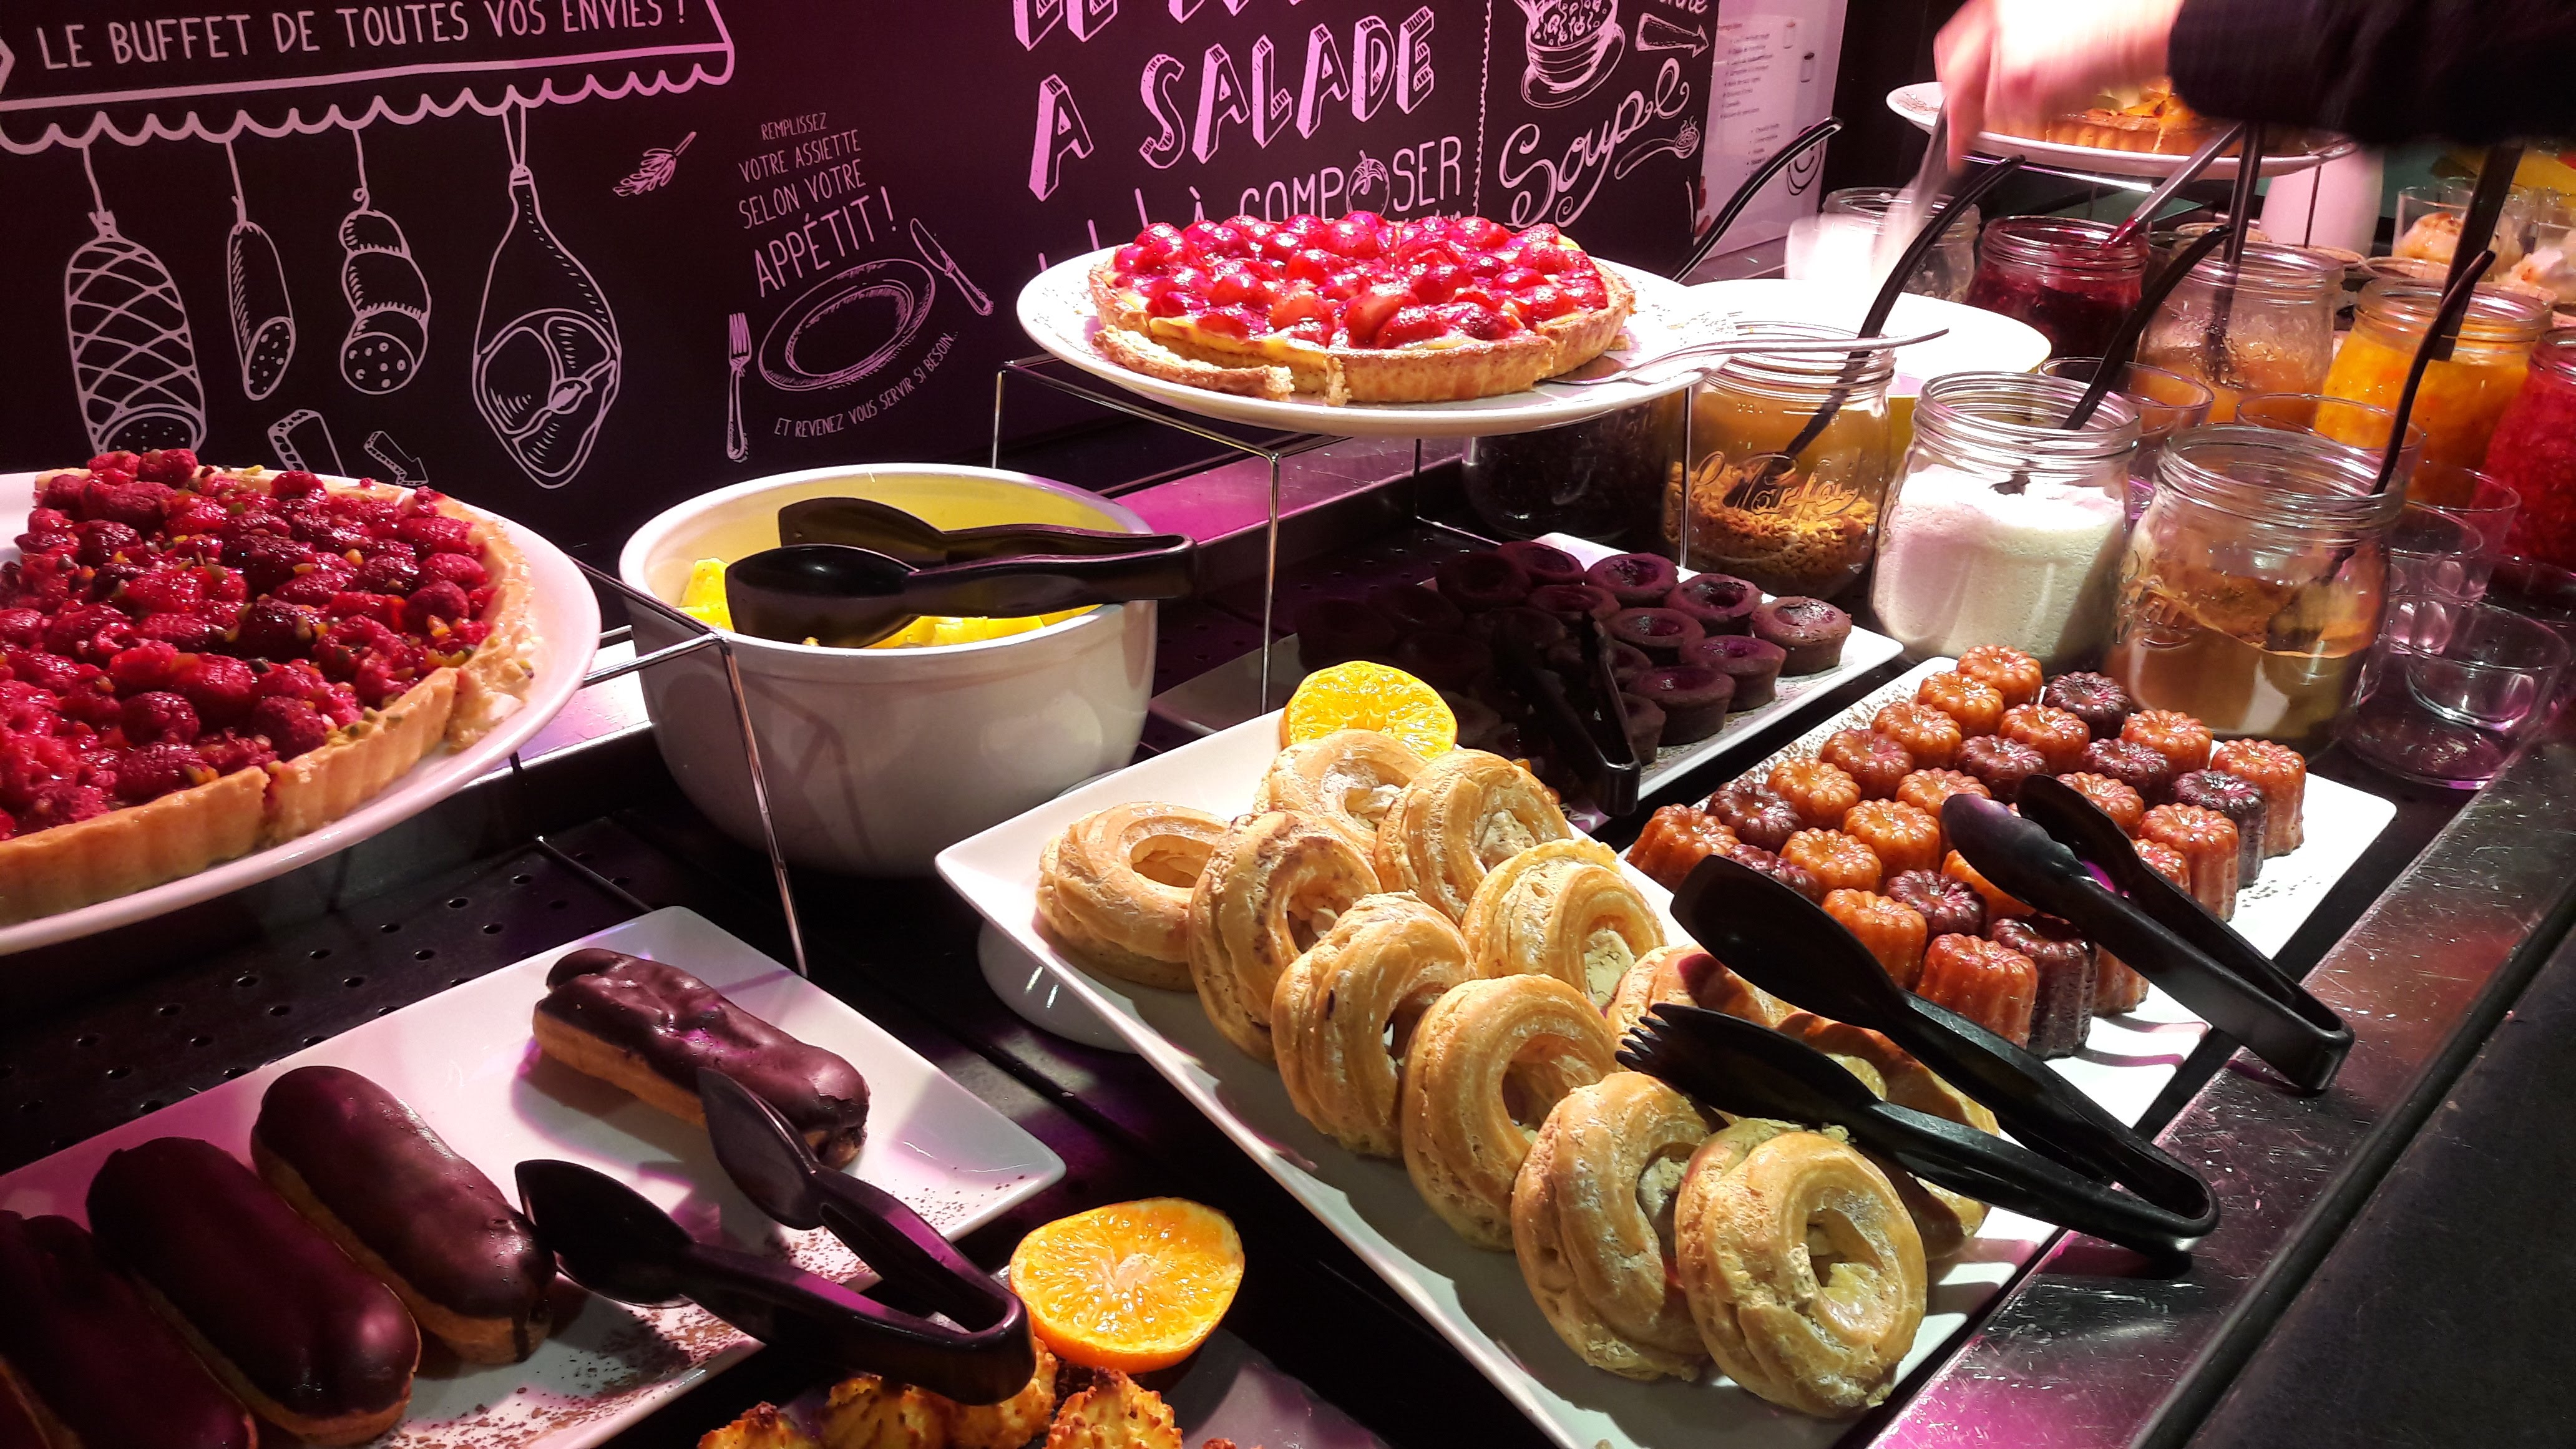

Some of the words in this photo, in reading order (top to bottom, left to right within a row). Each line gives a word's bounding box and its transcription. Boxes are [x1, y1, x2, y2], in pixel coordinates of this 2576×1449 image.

[36, 23, 92, 69] LE
[109, 13, 251, 65] BUFFET
[273, 9, 320, 53] DE
[336, 1, 469, 48] TOUTES
[483, 0, 546, 37] VOS
[562, 0, 663, 32] ENVIES
[761, 112, 828, 141] REMPLISSEZ
[1028, 74, 1094, 202] A
[1139, 5, 1435, 169] SALADE
[738, 150, 789, 183] VOTRE
[794, 129, 862, 169] ASSIETTE
[1498, 57, 1690, 228] Soupe
[738, 182, 801, 230] SELON
[803, 158, 867, 203] VOTRE
[754, 195, 875, 298] APPÉTIT
[881, 186, 897, 232] !
[774, 417, 792, 437] ET
[795, 413, 844, 437] REVENEZ
[847, 399, 878, 425] VOUS
[879, 377, 915, 410] SERVIR
[913, 366, 927, 384] SI
